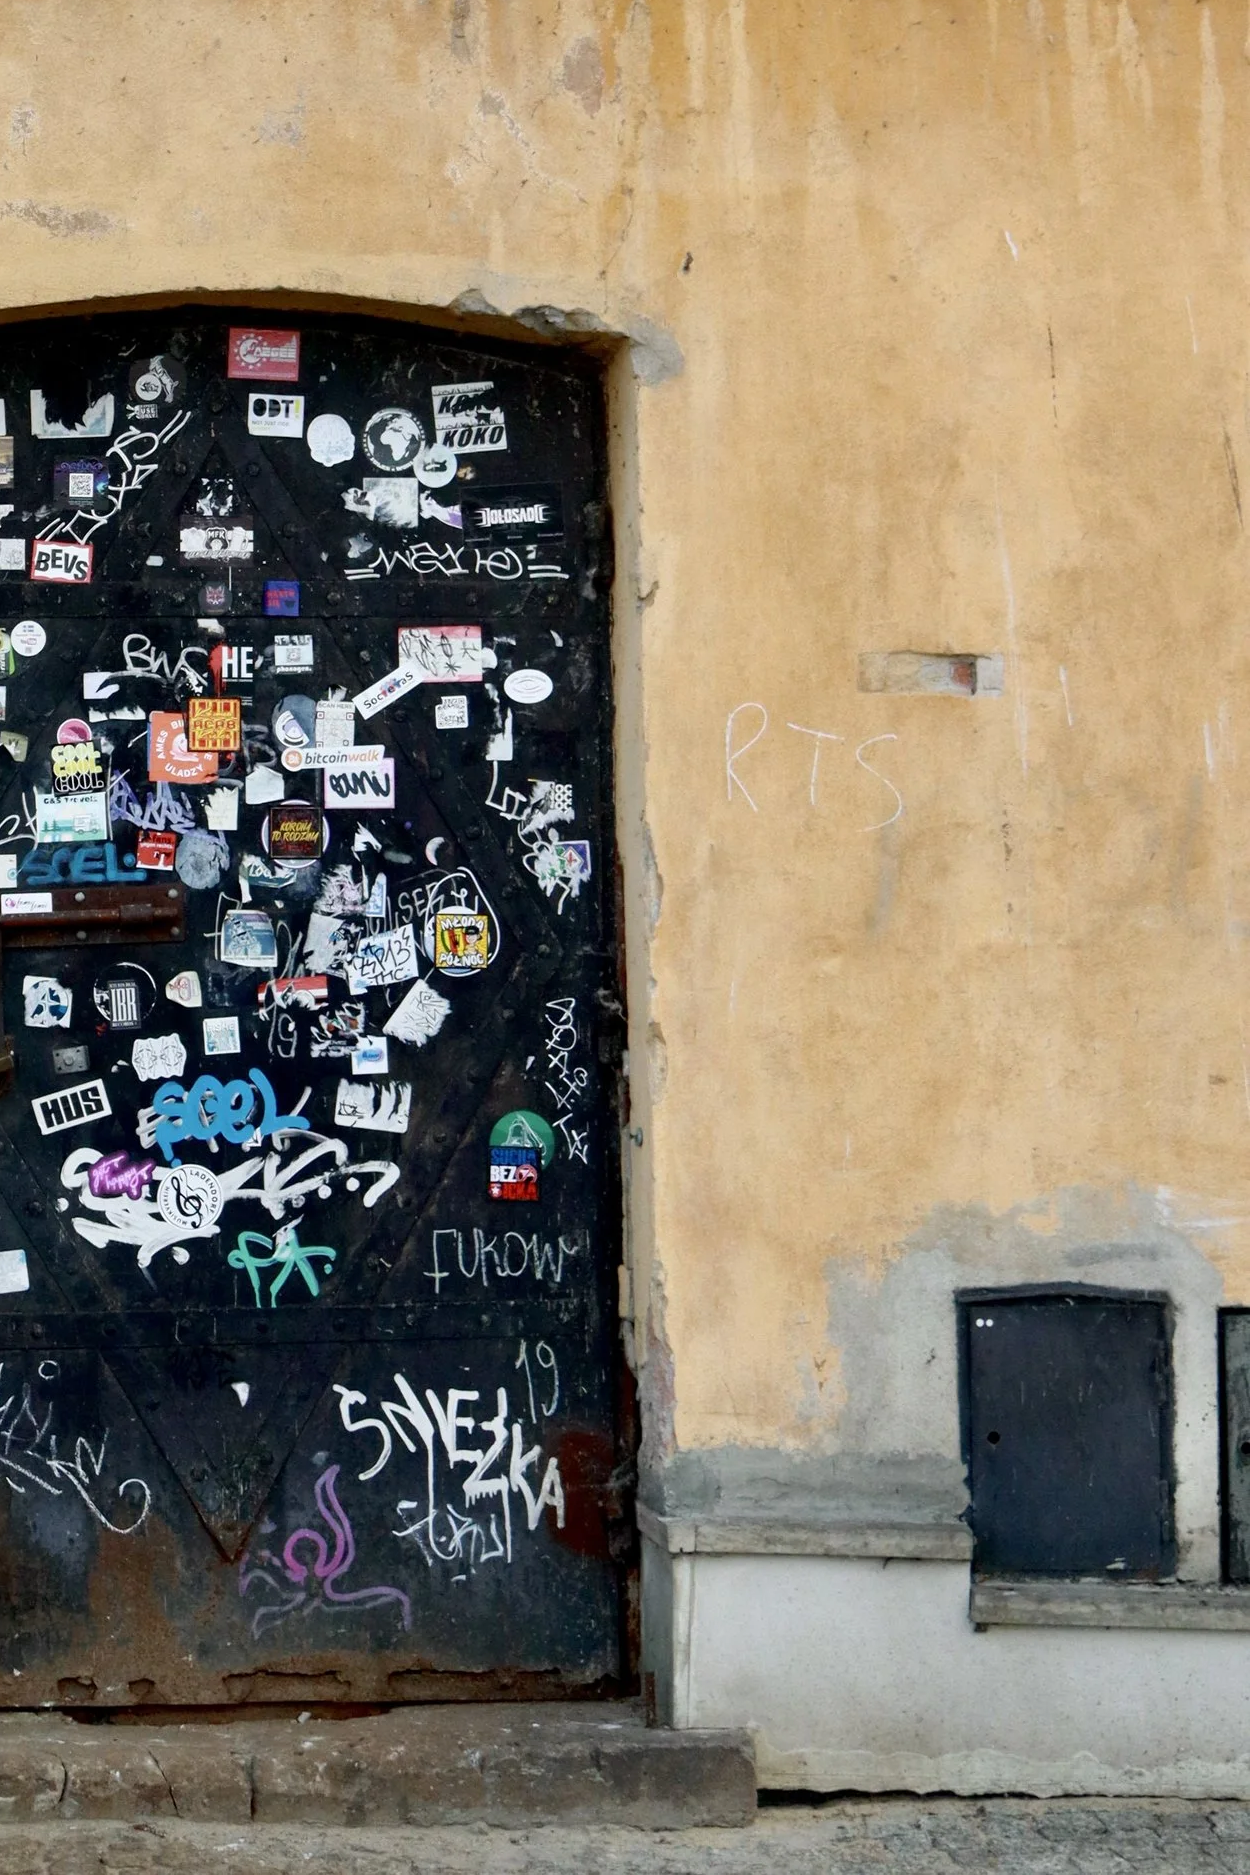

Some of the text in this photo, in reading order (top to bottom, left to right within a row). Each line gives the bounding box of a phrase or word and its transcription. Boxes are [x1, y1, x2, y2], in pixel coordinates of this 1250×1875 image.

[442, 425, 505, 450] KOKO
[206, 530, 226, 539] MFK
[34, 548, 90, 582] BEVS
[221, 646, 254, 678] HE
[304, 749, 380, 766] bitcoinwalk
[724, 701, 902, 833] RTS
[439, 952, 484, 968] PÓŁNOC
[110, 987, 138, 1022] IBR
[490, 1165, 517, 1182] BEZ
[189, 1169, 218, 1214] LADENDORF
